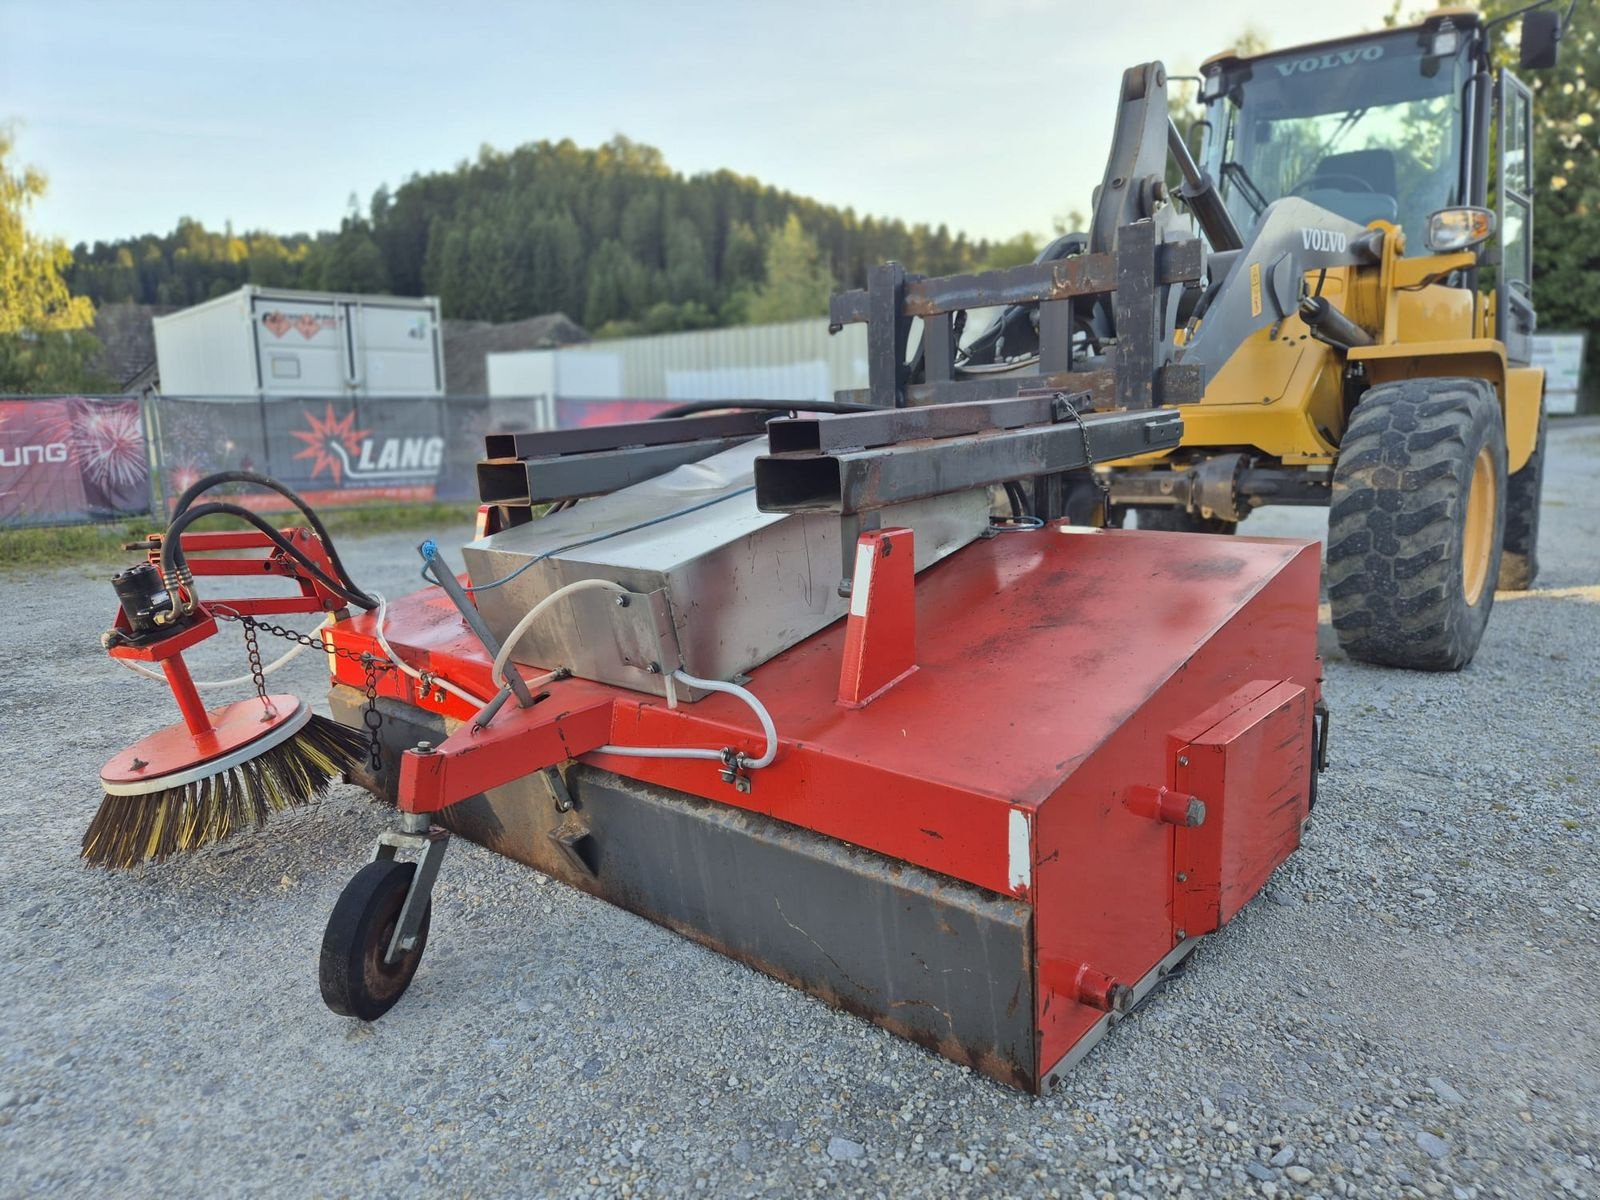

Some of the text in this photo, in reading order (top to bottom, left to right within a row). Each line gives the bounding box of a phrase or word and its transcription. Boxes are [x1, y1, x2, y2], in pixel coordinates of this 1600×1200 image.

[1274, 45, 1385, 76] VOLVO
[1301, 227, 1347, 253] VOLVO
[358, 436, 445, 470] LANG
